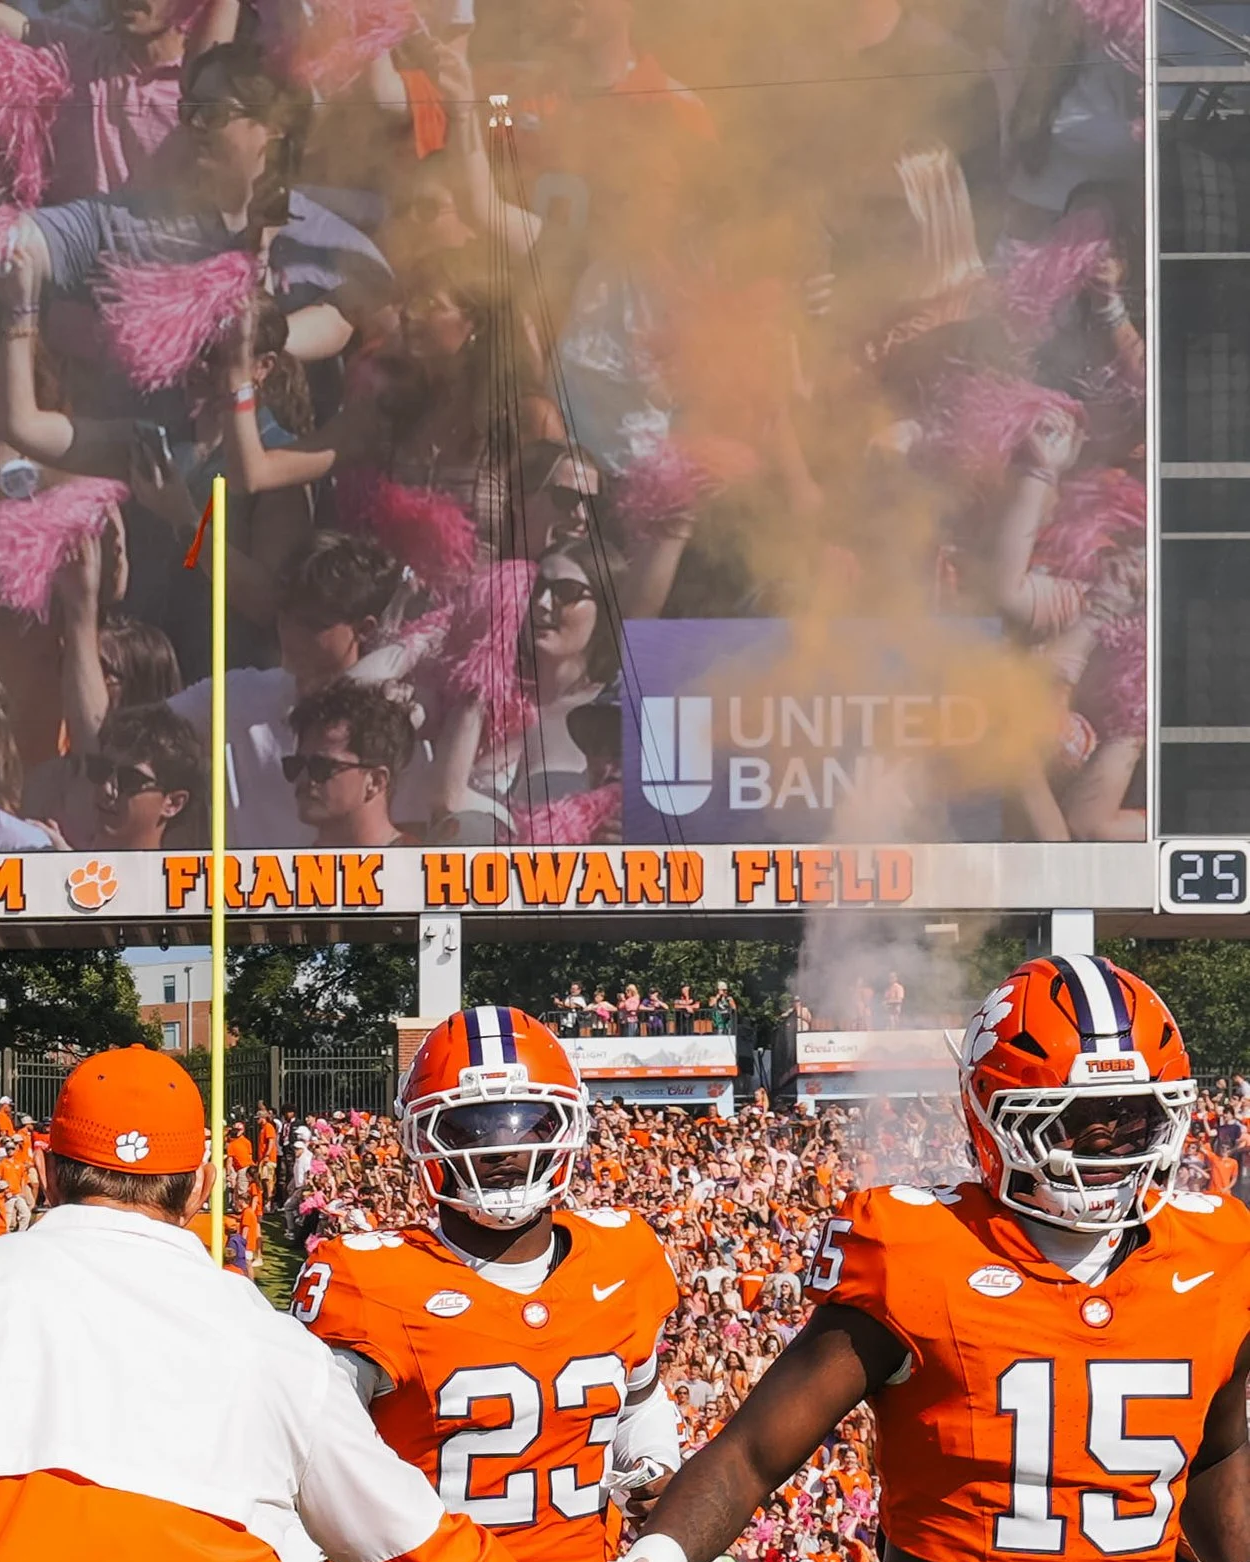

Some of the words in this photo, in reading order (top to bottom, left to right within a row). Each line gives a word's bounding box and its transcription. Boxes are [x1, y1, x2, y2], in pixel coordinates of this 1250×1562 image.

[729, 696, 988, 748] UNITED
[729, 757, 914, 809] BANK
[163, 853, 384, 909] FRANK
[423, 850, 704, 906] HOWARD
[734, 849, 915, 904] FIELD
[1177, 854, 1239, 900] 25
[1086, 1059, 1135, 1072] TIGERS
[433, 1297, 464, 1307] ACC
[978, 1273, 1014, 1286] ACC
[436, 1352, 628, 1528] 23
[992, 1359, 1193, 1556] 15
